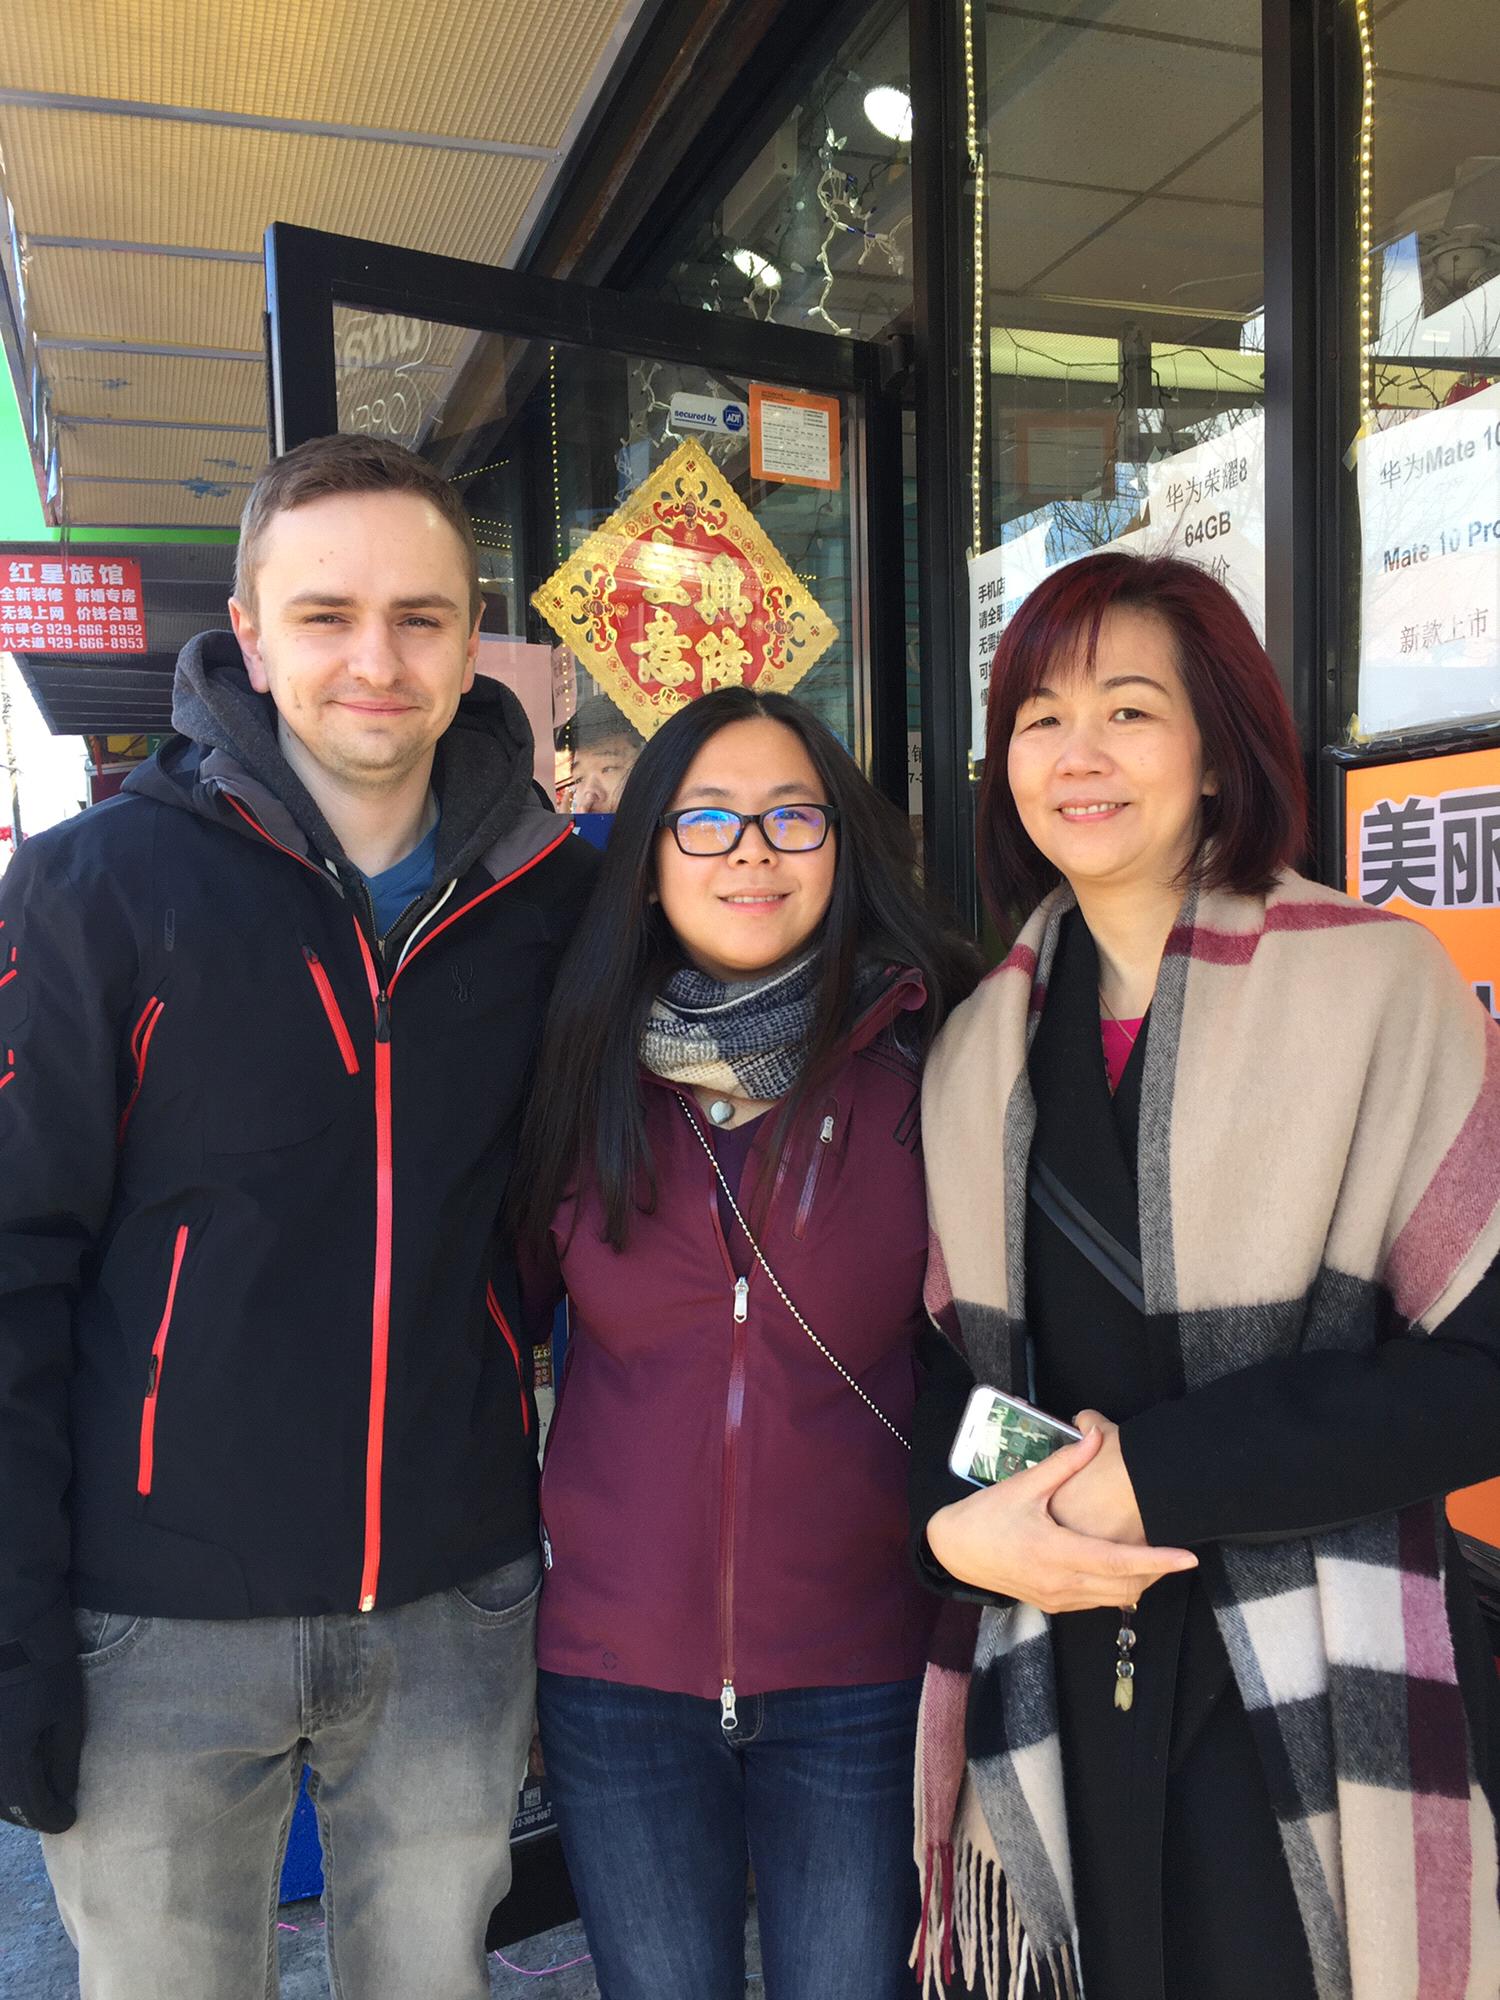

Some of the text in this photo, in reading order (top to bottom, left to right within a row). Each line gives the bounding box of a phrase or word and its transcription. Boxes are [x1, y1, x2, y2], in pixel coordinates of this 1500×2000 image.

[674, 410, 717, 423] secured by
[1166, 457, 1248, 512] 华为荣耀8
[1184, 510, 1232, 548] 64GB
[1383, 541, 1430, 573] Mate
[1440, 527, 1461, 556] 10
[8, 561, 124, 586] 红星旅馆
[0, 586, 137, 603] 全新装修 新婚专房
[978, 577, 1005, 603] 手机店
[1, 604, 138, 621] 无线上网 价钱合理
[3, 637, 144, 649] 八大道 929-666-8953
[46, 624, 143, 637] 929-666-8952
[978, 631, 1002, 655] 无需
[1400, 607, 1488, 654] 新款上市
[1362, 792, 1500, 906] 美丽
